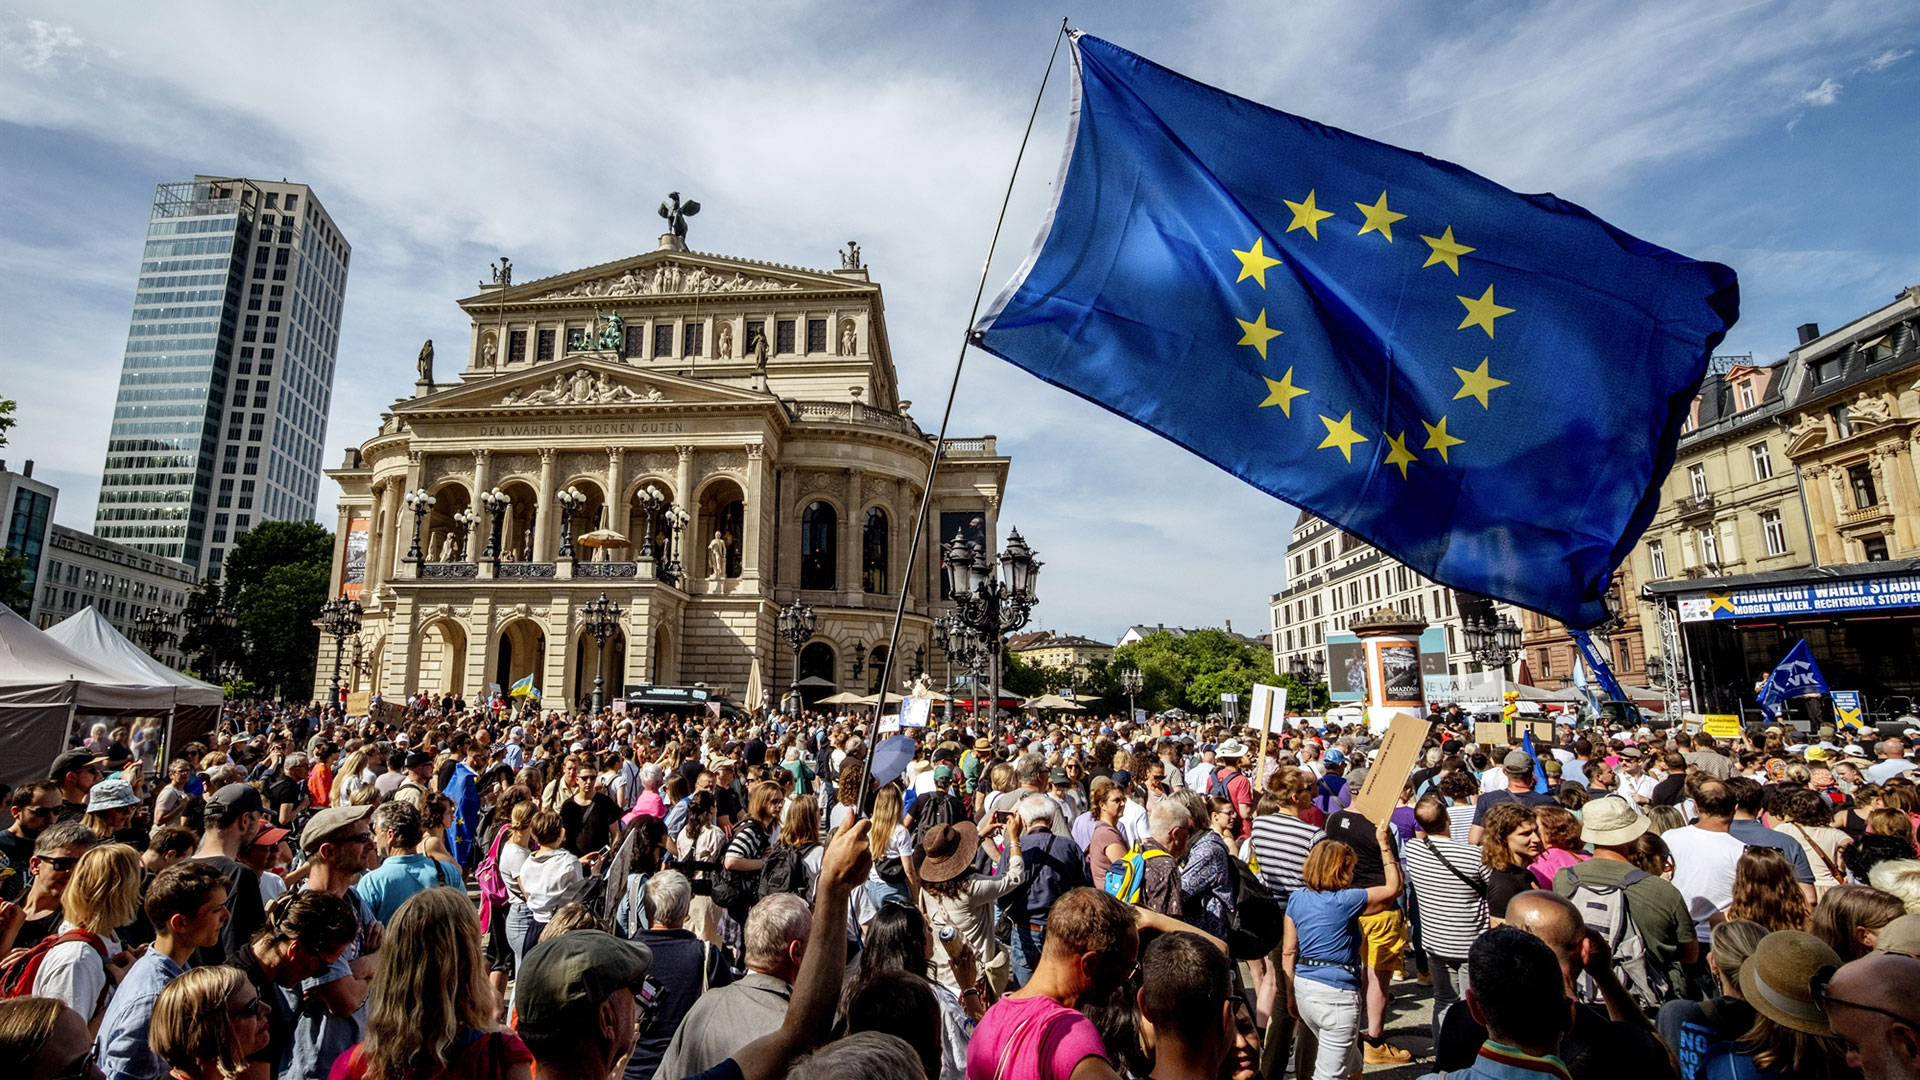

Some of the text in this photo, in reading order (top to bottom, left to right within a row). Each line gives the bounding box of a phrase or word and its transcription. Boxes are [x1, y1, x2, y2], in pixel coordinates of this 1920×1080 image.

[480, 422, 687, 436] DEM WAHREN SCHOENEN GUTEN.
[1732, 585, 1809, 604] FRANKFURT
[1734, 603, 1771, 615] MORGEN
[1814, 595, 1876, 609] RECHTSRUCK
[1440, 681, 1475, 692] WAL
[1680, 1029, 1707, 1053] NO
[1680, 1048, 1698, 1064] NO
